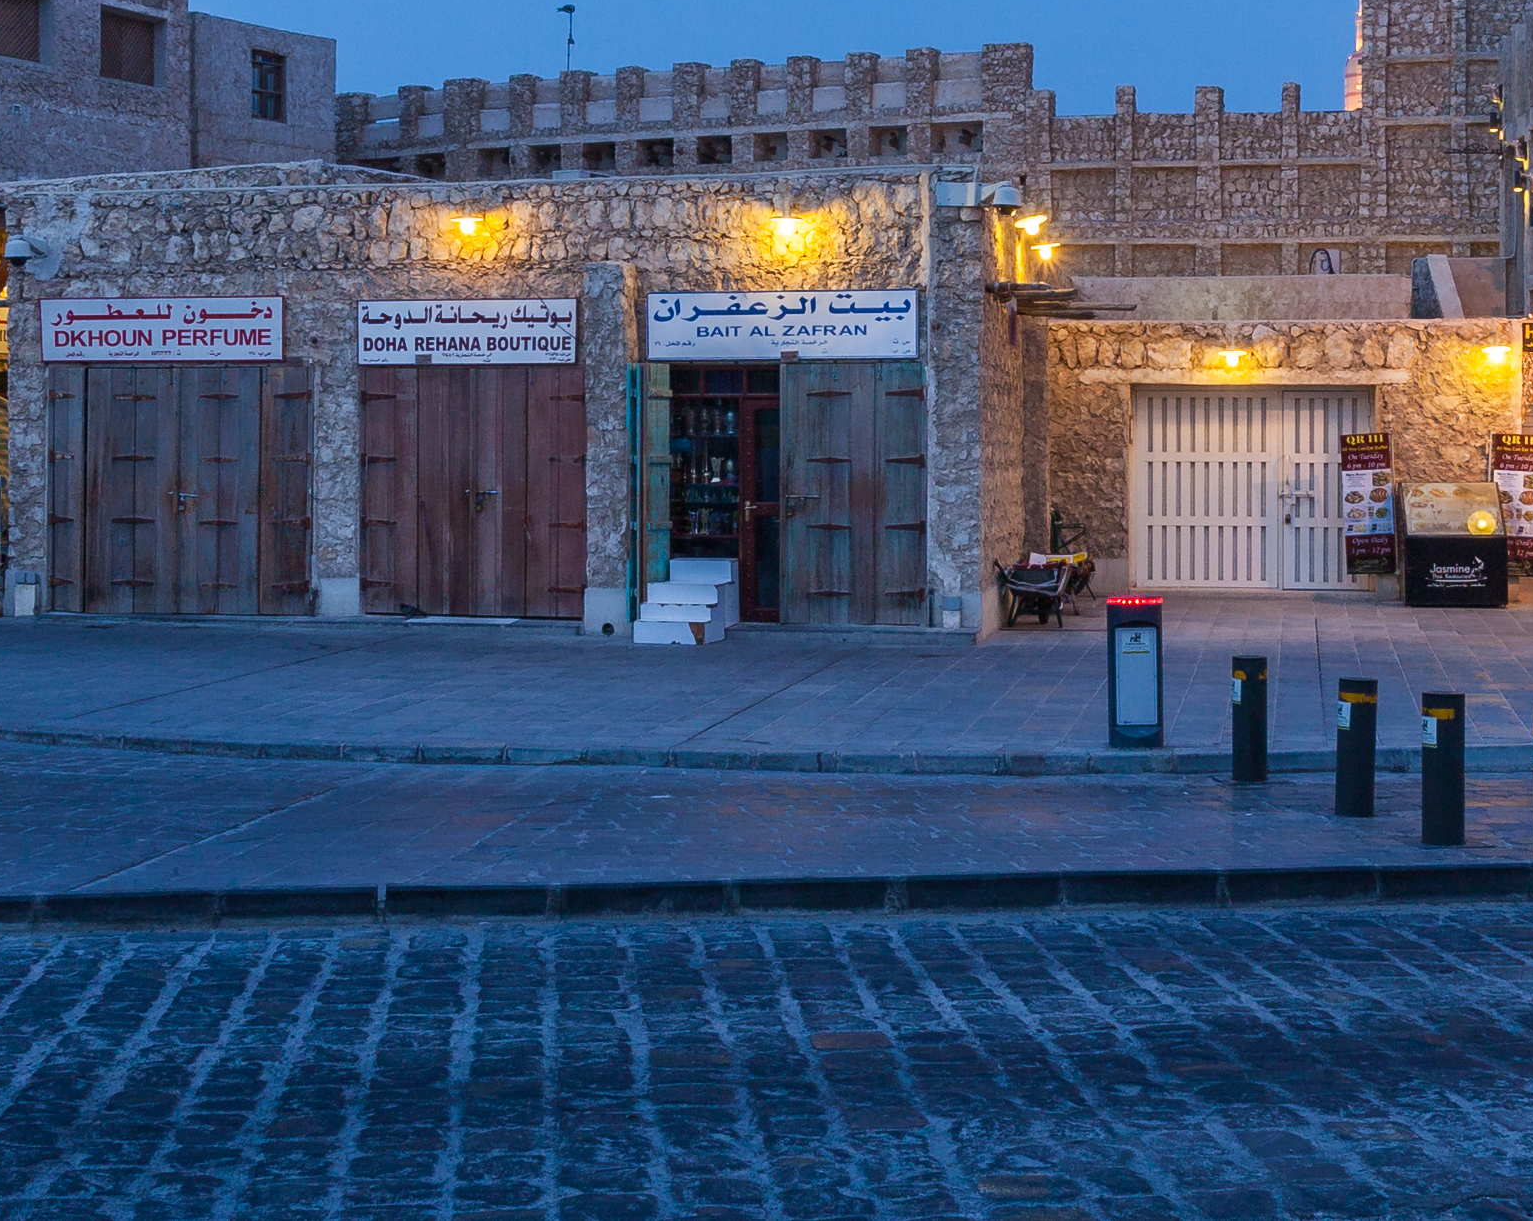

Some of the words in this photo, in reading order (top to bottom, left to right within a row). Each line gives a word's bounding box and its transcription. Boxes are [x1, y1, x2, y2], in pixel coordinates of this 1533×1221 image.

[50, 303, 173, 326] للعطور
[183, 300, 273, 325] دخون
[361, 305, 433, 330] الدوحة
[434, 304, 508, 329] ريحانة
[510, 304, 573, 329] بوتيك
[653, 294, 817, 323] الزعفران
[828, 293, 912, 322] بيت
[54, 330, 153, 347] DKHOUN
[162, 329, 272, 346] PERFUME
[696, 326, 743, 338] BAIT
[749, 326, 776, 337] AL
[782, 324, 868, 337] ZAFRAN
[363, 337, 408, 352] DOHA
[415, 336, 482, 352] REHANA
[486, 336, 572, 352] BOUTIQUE
[1346, 435, 1365, 445] QR
[1502, 435, 1521, 445] QR
[1429, 563, 1471, 573] Jasmine
